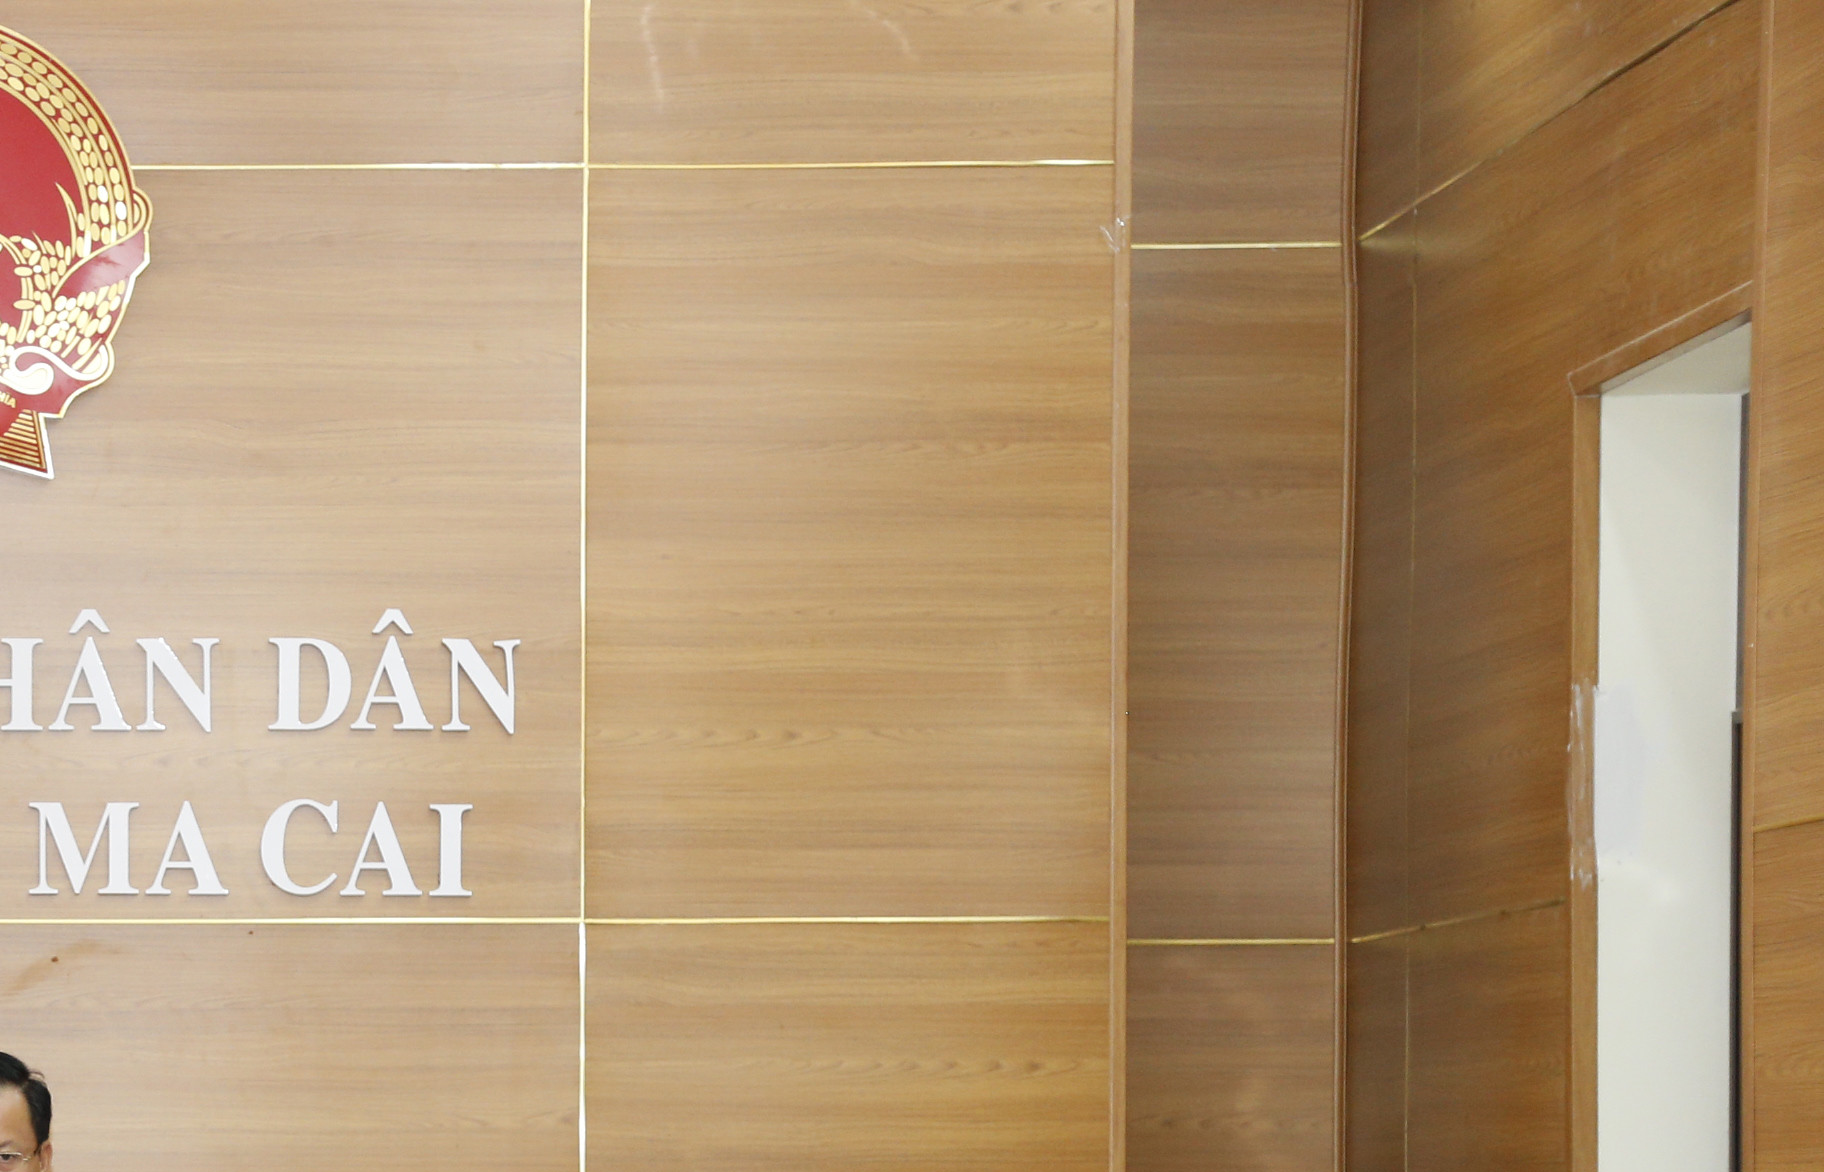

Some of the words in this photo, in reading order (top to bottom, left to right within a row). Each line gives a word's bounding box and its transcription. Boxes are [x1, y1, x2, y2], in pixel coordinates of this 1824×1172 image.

[267, 608, 522, 735] DÂN
[28, 800, 230, 896] MA
[259, 798, 474, 897] CAI
